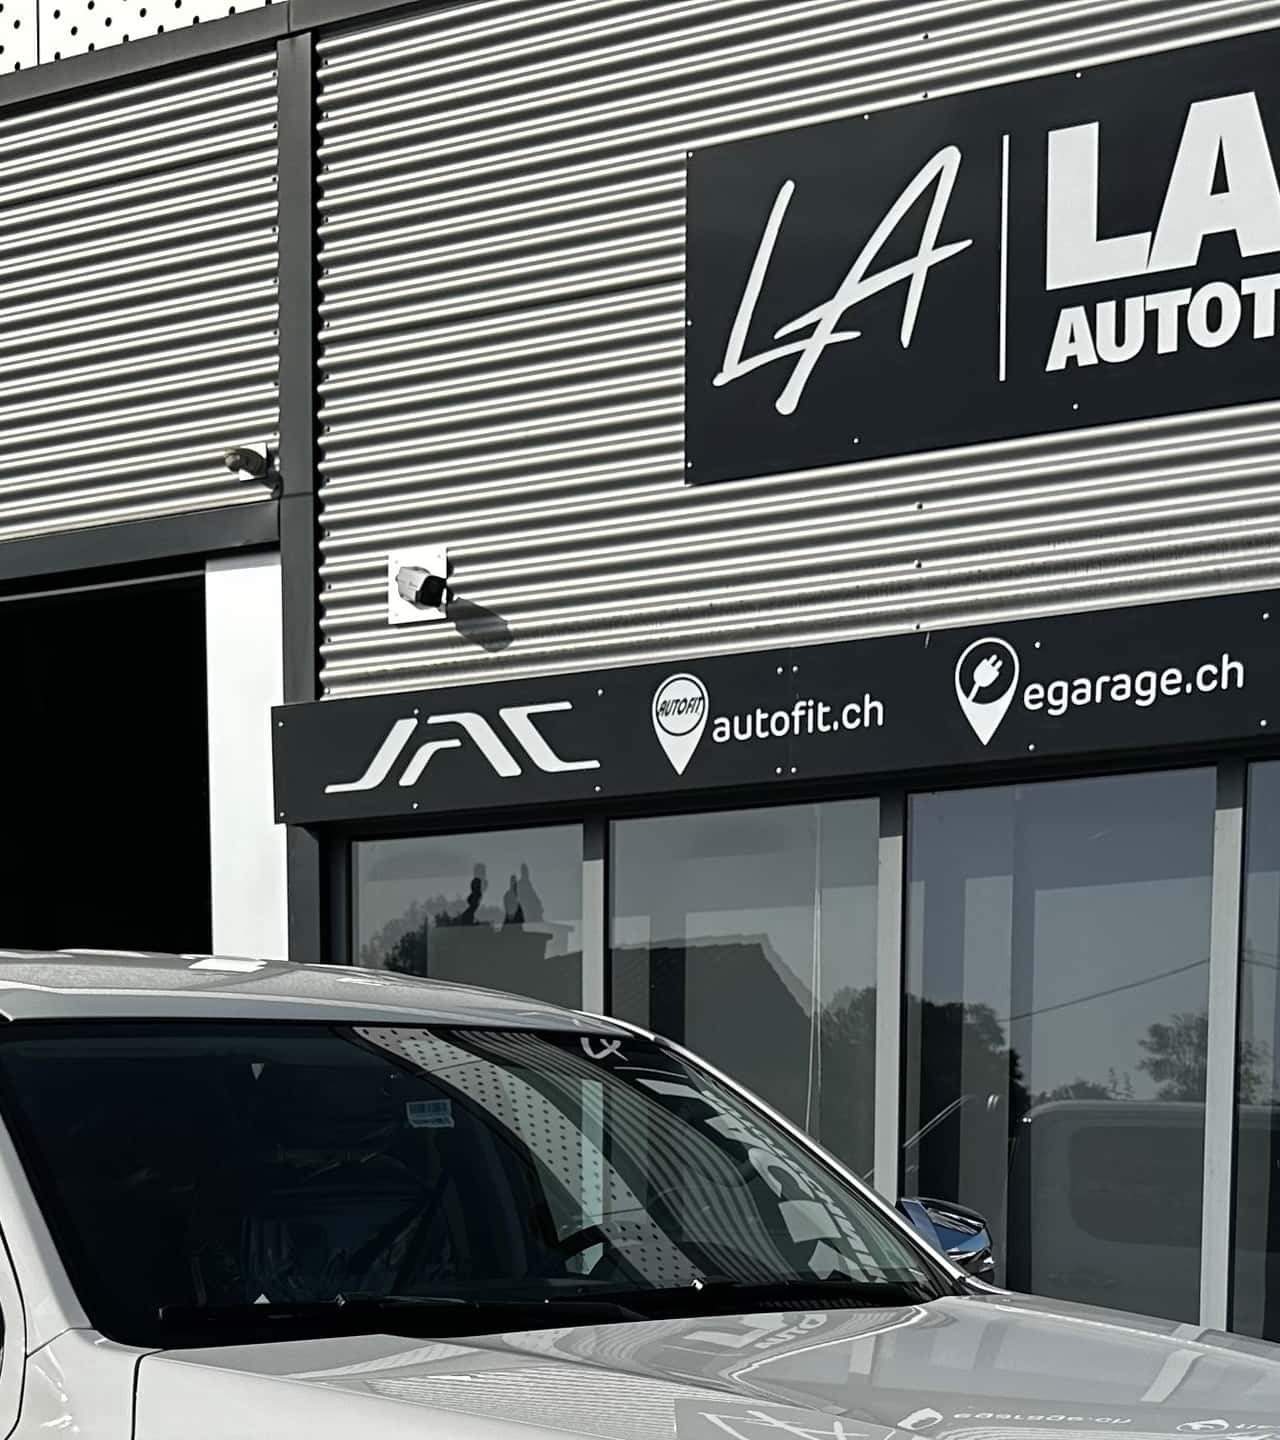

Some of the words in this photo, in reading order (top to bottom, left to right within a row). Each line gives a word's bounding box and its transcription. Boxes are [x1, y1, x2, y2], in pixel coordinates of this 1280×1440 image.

[712, 144, 973, 415] LA
[659, 696, 704, 717] AUTOFIT
[1022, 653, 1245, 715] egarage.ch
[324, 700, 601, 795] JAC
[711, 693, 885, 744] autofit.ch
